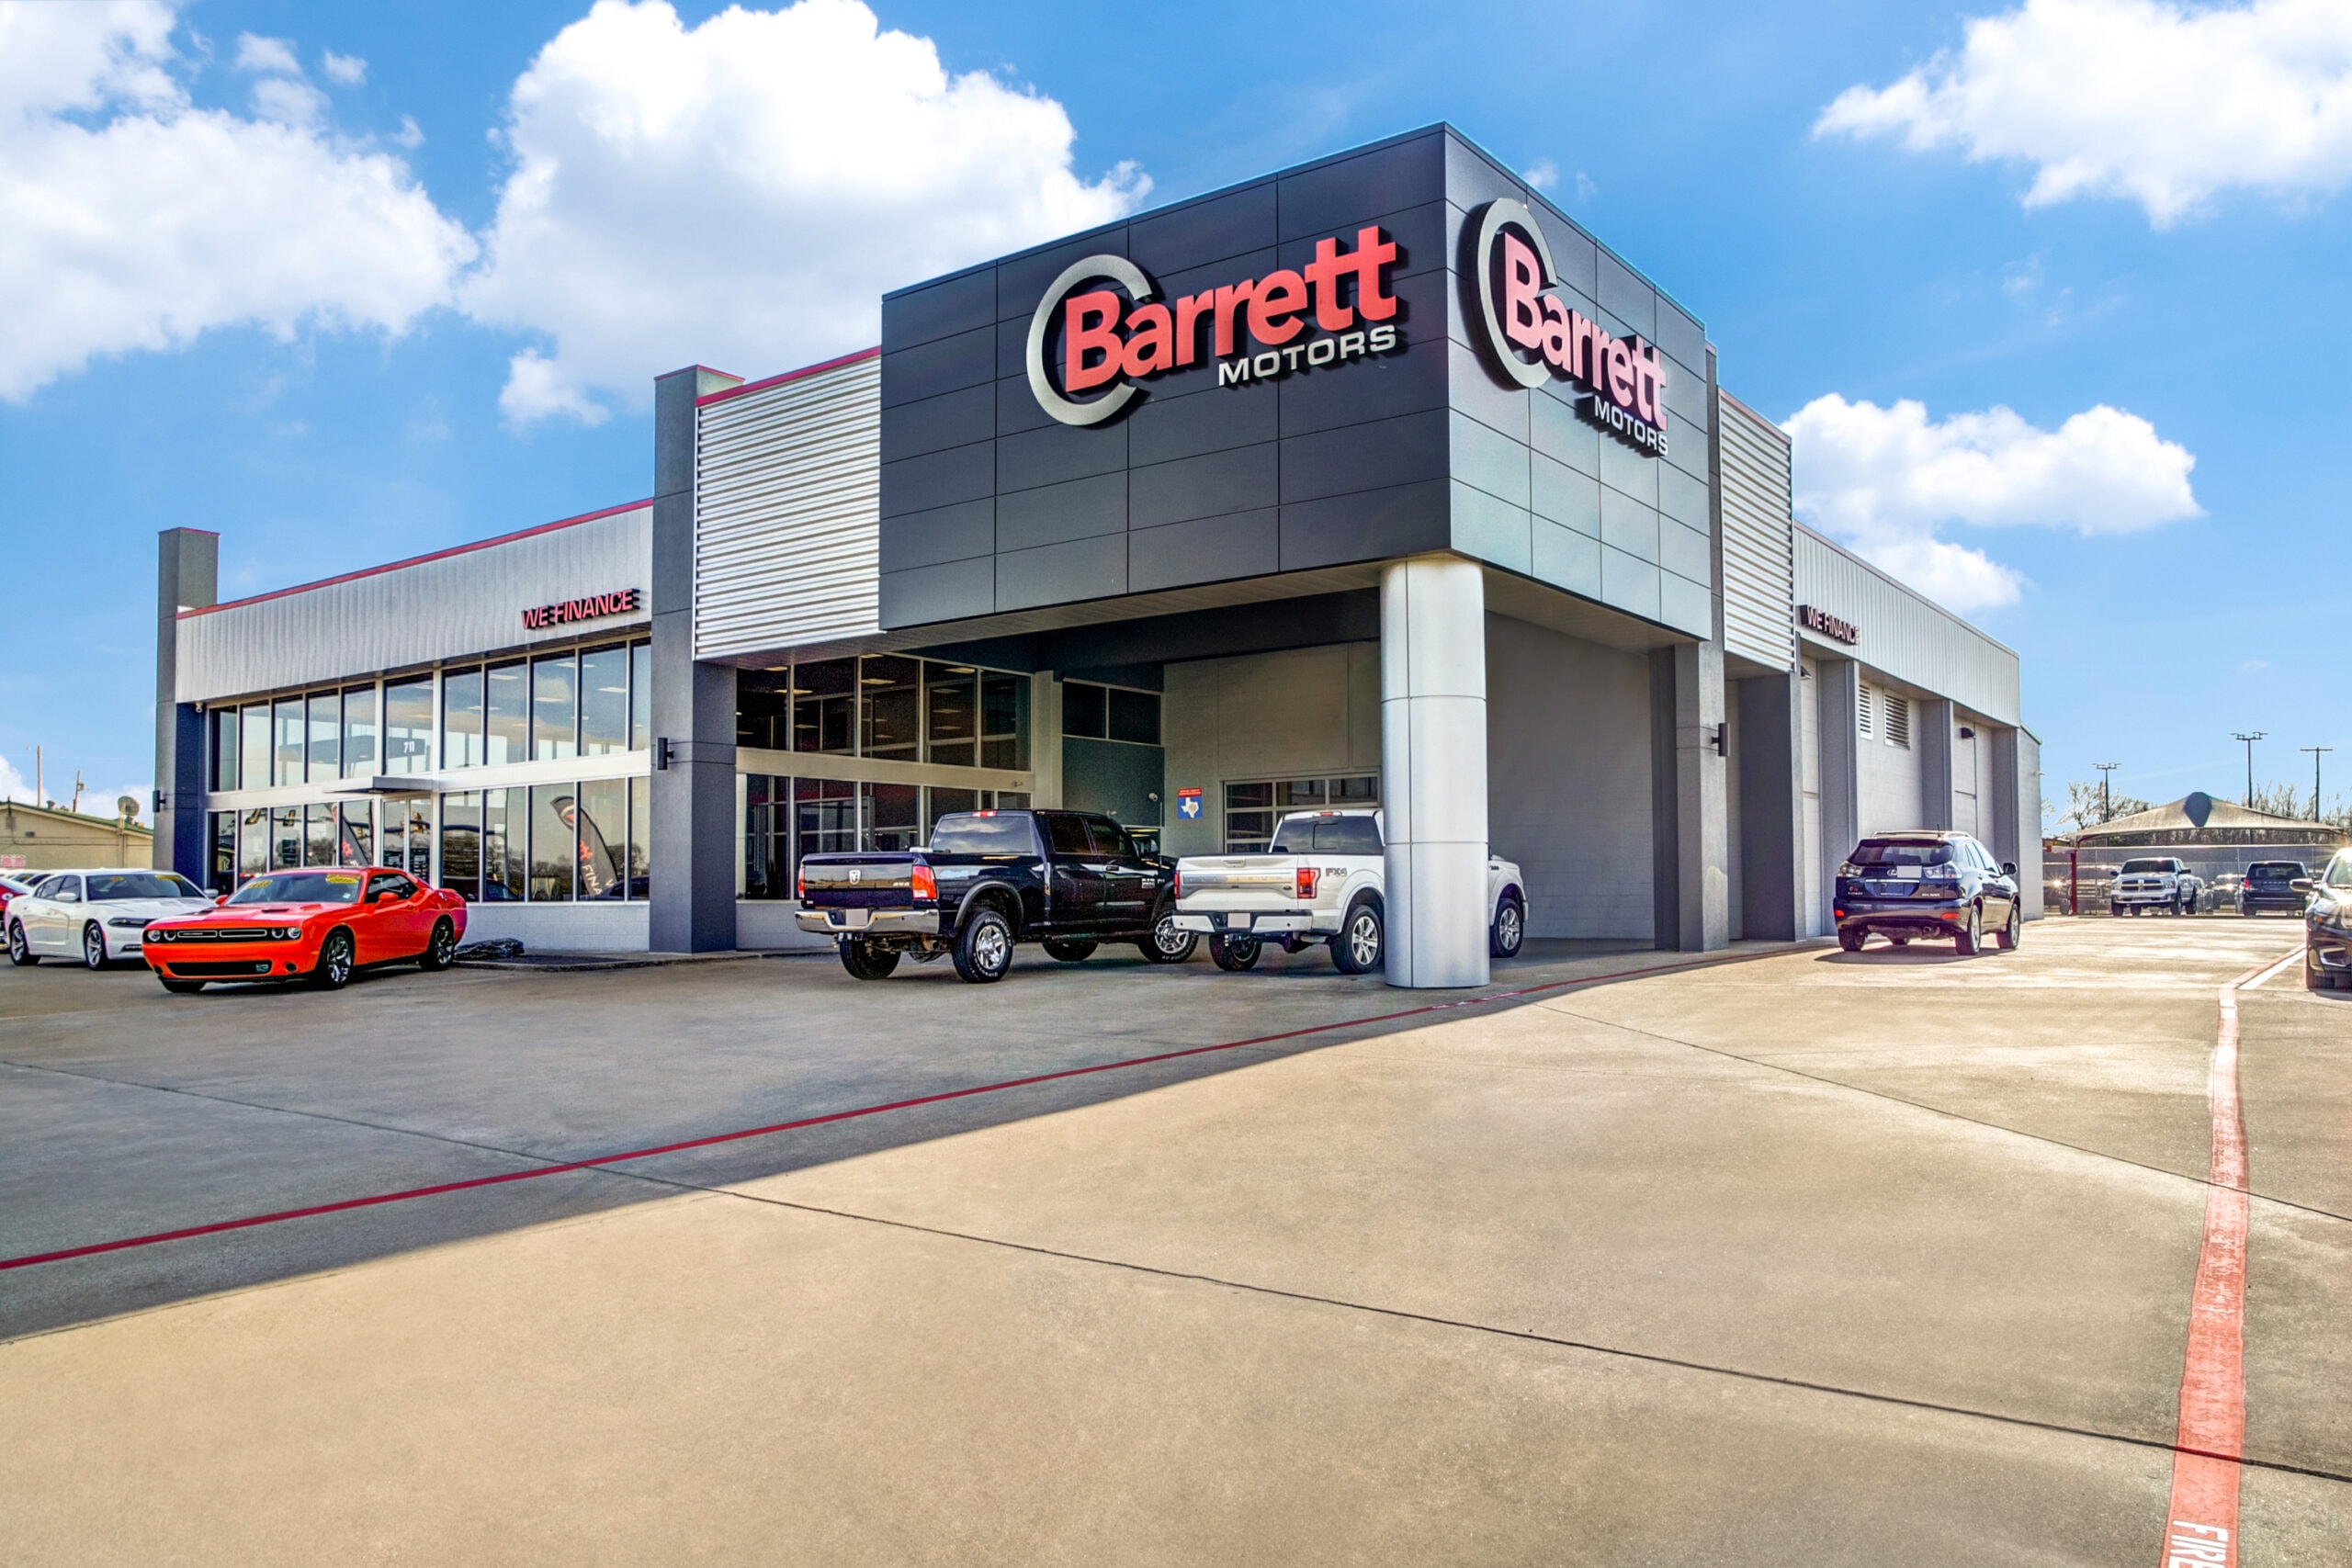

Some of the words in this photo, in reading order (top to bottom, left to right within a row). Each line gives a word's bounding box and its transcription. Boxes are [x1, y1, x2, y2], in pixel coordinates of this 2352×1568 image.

[1066, 225, 1396, 392] Barrett
[1504, 231, 1668, 432] Barrett
[1217, 323, 1396, 387] MOTORS
[1593, 395, 1669, 457] MOTORS
[521, 605, 549, 630] WE
[553, 588, 634, 623] FINANCE
[1807, 606, 1823, 630] WE
[582, 864, 603, 896] FINA
[1325, 867, 1348, 877] FX4
